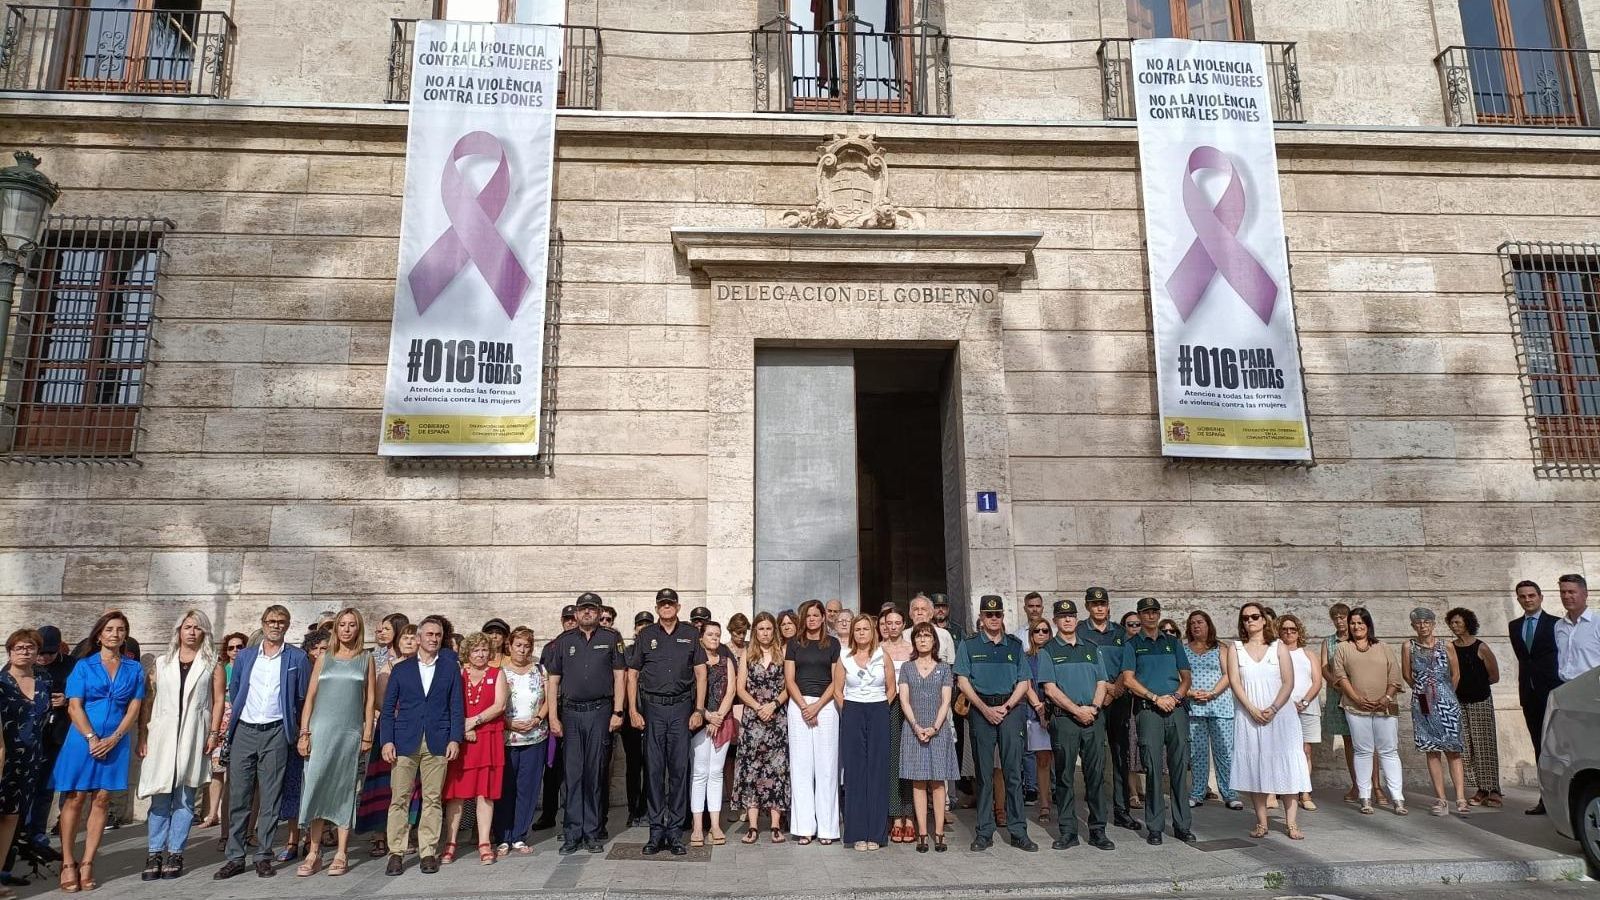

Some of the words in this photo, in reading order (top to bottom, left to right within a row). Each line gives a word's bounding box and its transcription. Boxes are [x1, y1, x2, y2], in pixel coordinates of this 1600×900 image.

[430, 41, 447, 52] NO
[451, 42, 458, 53] A
[463, 42, 476, 52] LA
[481, 42, 545, 57] VIOLENCIA
[419, 53, 468, 66] CONTRA
[471, 55, 493, 67] LAS
[497, 56, 553, 70] MUJERES
[1147, 59, 1163, 70] NO
[1167, 59, 1174, 70] A
[1177, 59, 1191, 71] LA
[1193, 59, 1253, 73] VIOLENCIA
[425, 75, 443, 87] NO
[447, 76, 454, 87] A
[459, 76, 474, 89] LA
[478, 77, 542, 93] VIOLÈNCIA
[1139, 72, 1185, 84] CONTRA
[1188, 72, 1208, 84] LAS
[1212, 73, 1262, 87] MUJERES
[424, 89, 473, 104] CONTRA
[477, 93, 497, 104] LES
[500, 93, 543, 107] DONES
[1150, 94, 1166, 106] NO
[1170, 95, 1177, 105] A
[1181, 94, 1194, 105] LA
[1197, 93, 1257, 109] VIOLÈNCIA
[1150, 107, 1196, 119] CONTRA
[1198, 109, 1218, 120] LES
[1222, 109, 1260, 122] DONES
[717, 285, 851, 302] DELEGACION
[857, 289, 888, 302] DEL
[894, 288, 994, 303] GOBIERNO
[407, 339, 475, 383] #016
[479, 341, 514, 363] PARA
[1178, 345, 1239, 389] #016
[1239, 349, 1275, 368] PARA
[478, 362, 521, 384] TODAS
[1241, 369, 1284, 389] TODAS
[982, 494, 990, 509] 1
